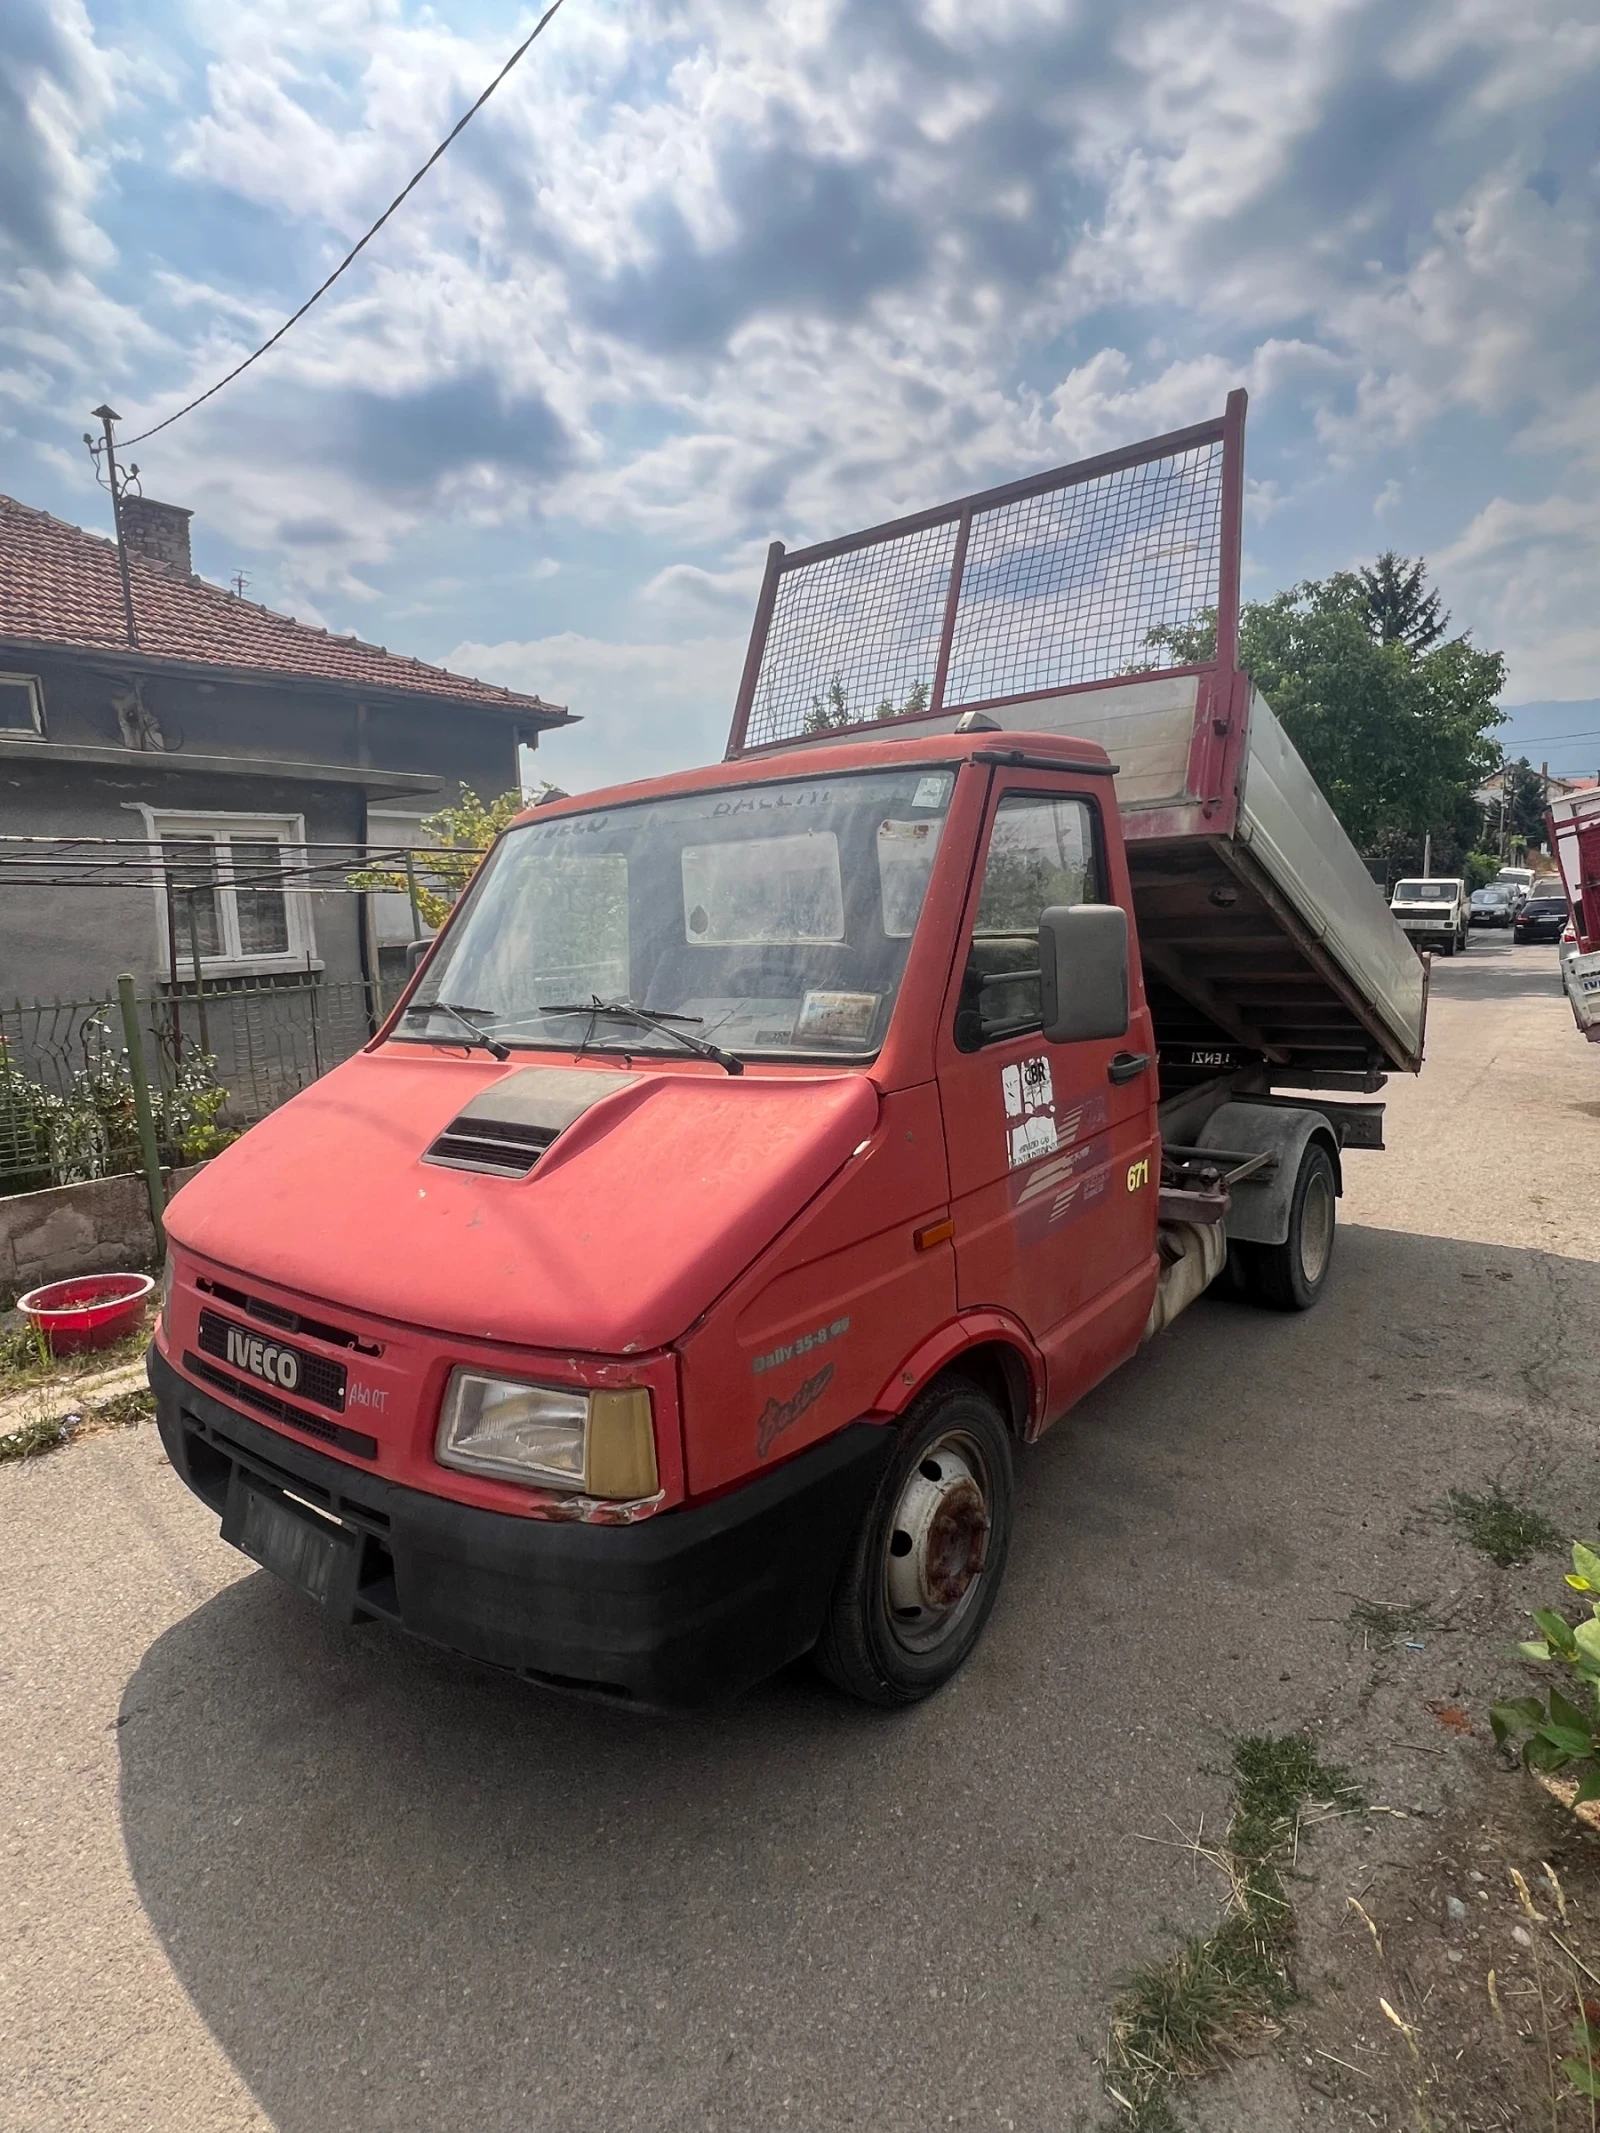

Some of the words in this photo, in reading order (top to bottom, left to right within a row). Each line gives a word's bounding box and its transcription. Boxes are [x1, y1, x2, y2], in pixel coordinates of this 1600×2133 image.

[1583, 980, 1600, 991] IV
[1127, 1158, 1149, 1192] 671
[226, 1328, 299, 1389] IVECO
